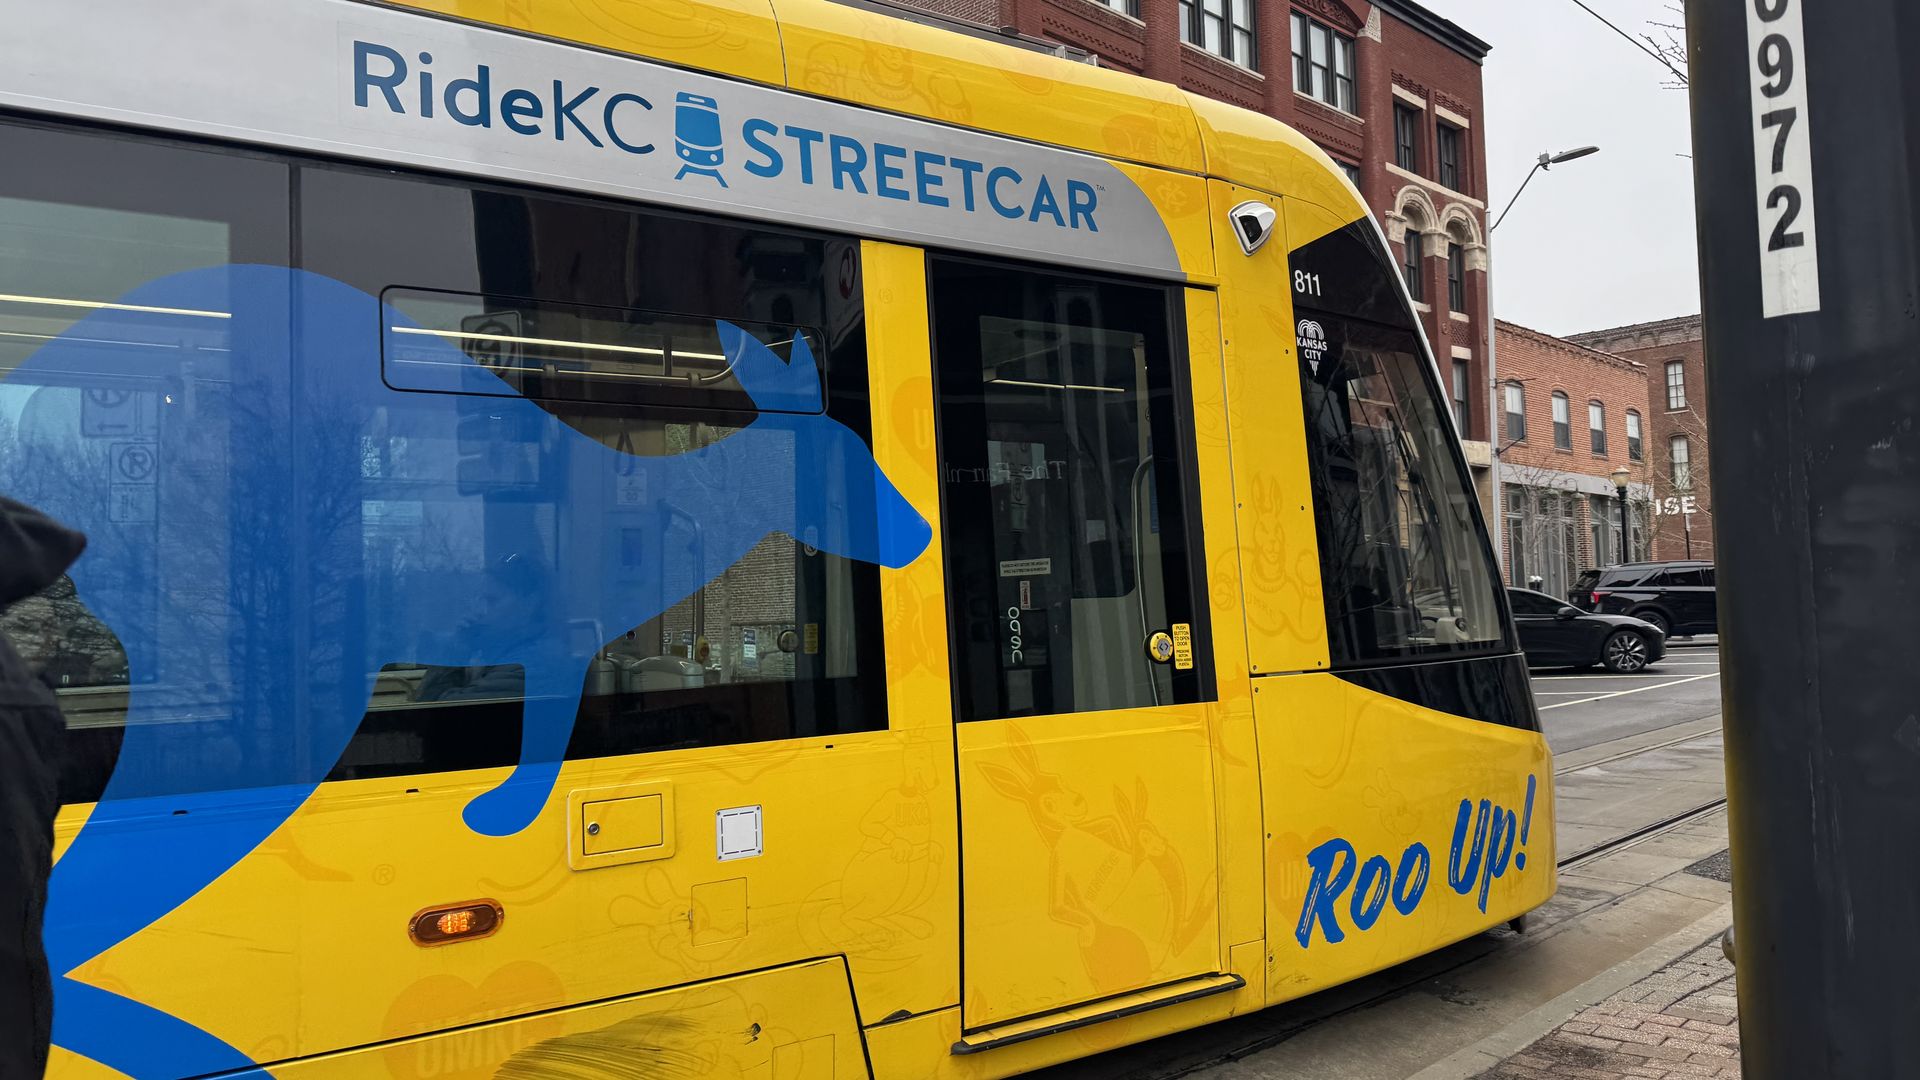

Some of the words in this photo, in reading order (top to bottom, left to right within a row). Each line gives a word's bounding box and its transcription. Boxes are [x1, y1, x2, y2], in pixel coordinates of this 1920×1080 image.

[353, 40, 655, 154] RideKC
[742, 118, 1099, 233] STREETCAR
[1294, 269, 1321, 296] 811
[1296, 336, 1328, 351] KANSAS
[1304, 348, 1322, 361] CITY
[1295, 837, 1431, 949] Roo
[1448, 774, 1536, 914] Up!
